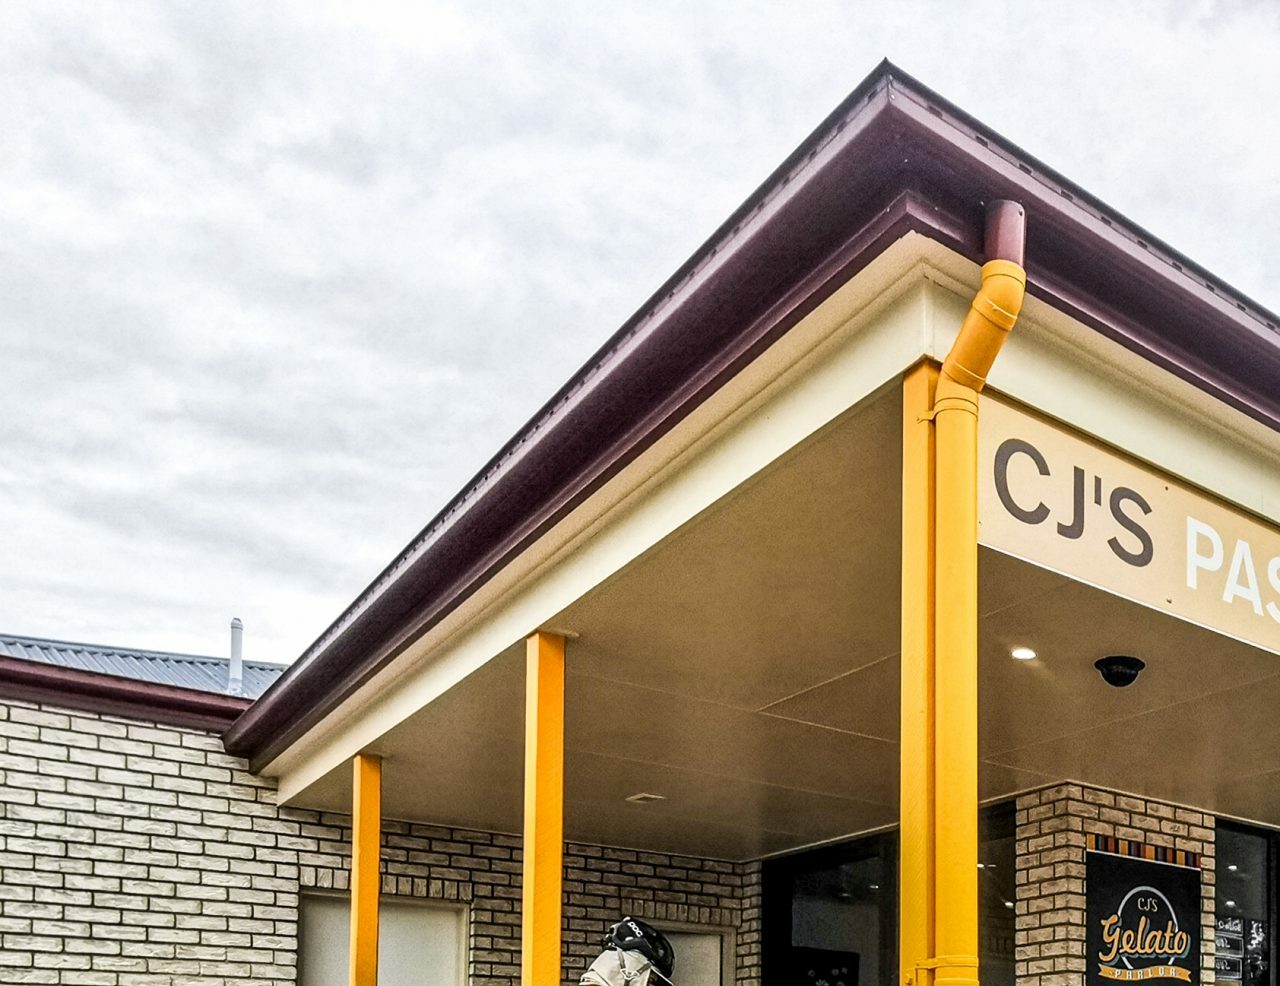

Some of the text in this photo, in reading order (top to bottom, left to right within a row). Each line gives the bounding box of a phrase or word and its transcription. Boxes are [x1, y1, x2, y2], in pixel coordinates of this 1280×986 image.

[994, 438, 1154, 568] CJ'S
[1099, 914, 1189, 963] Gelato
[1114, 966, 1177, 980] PARLOR
